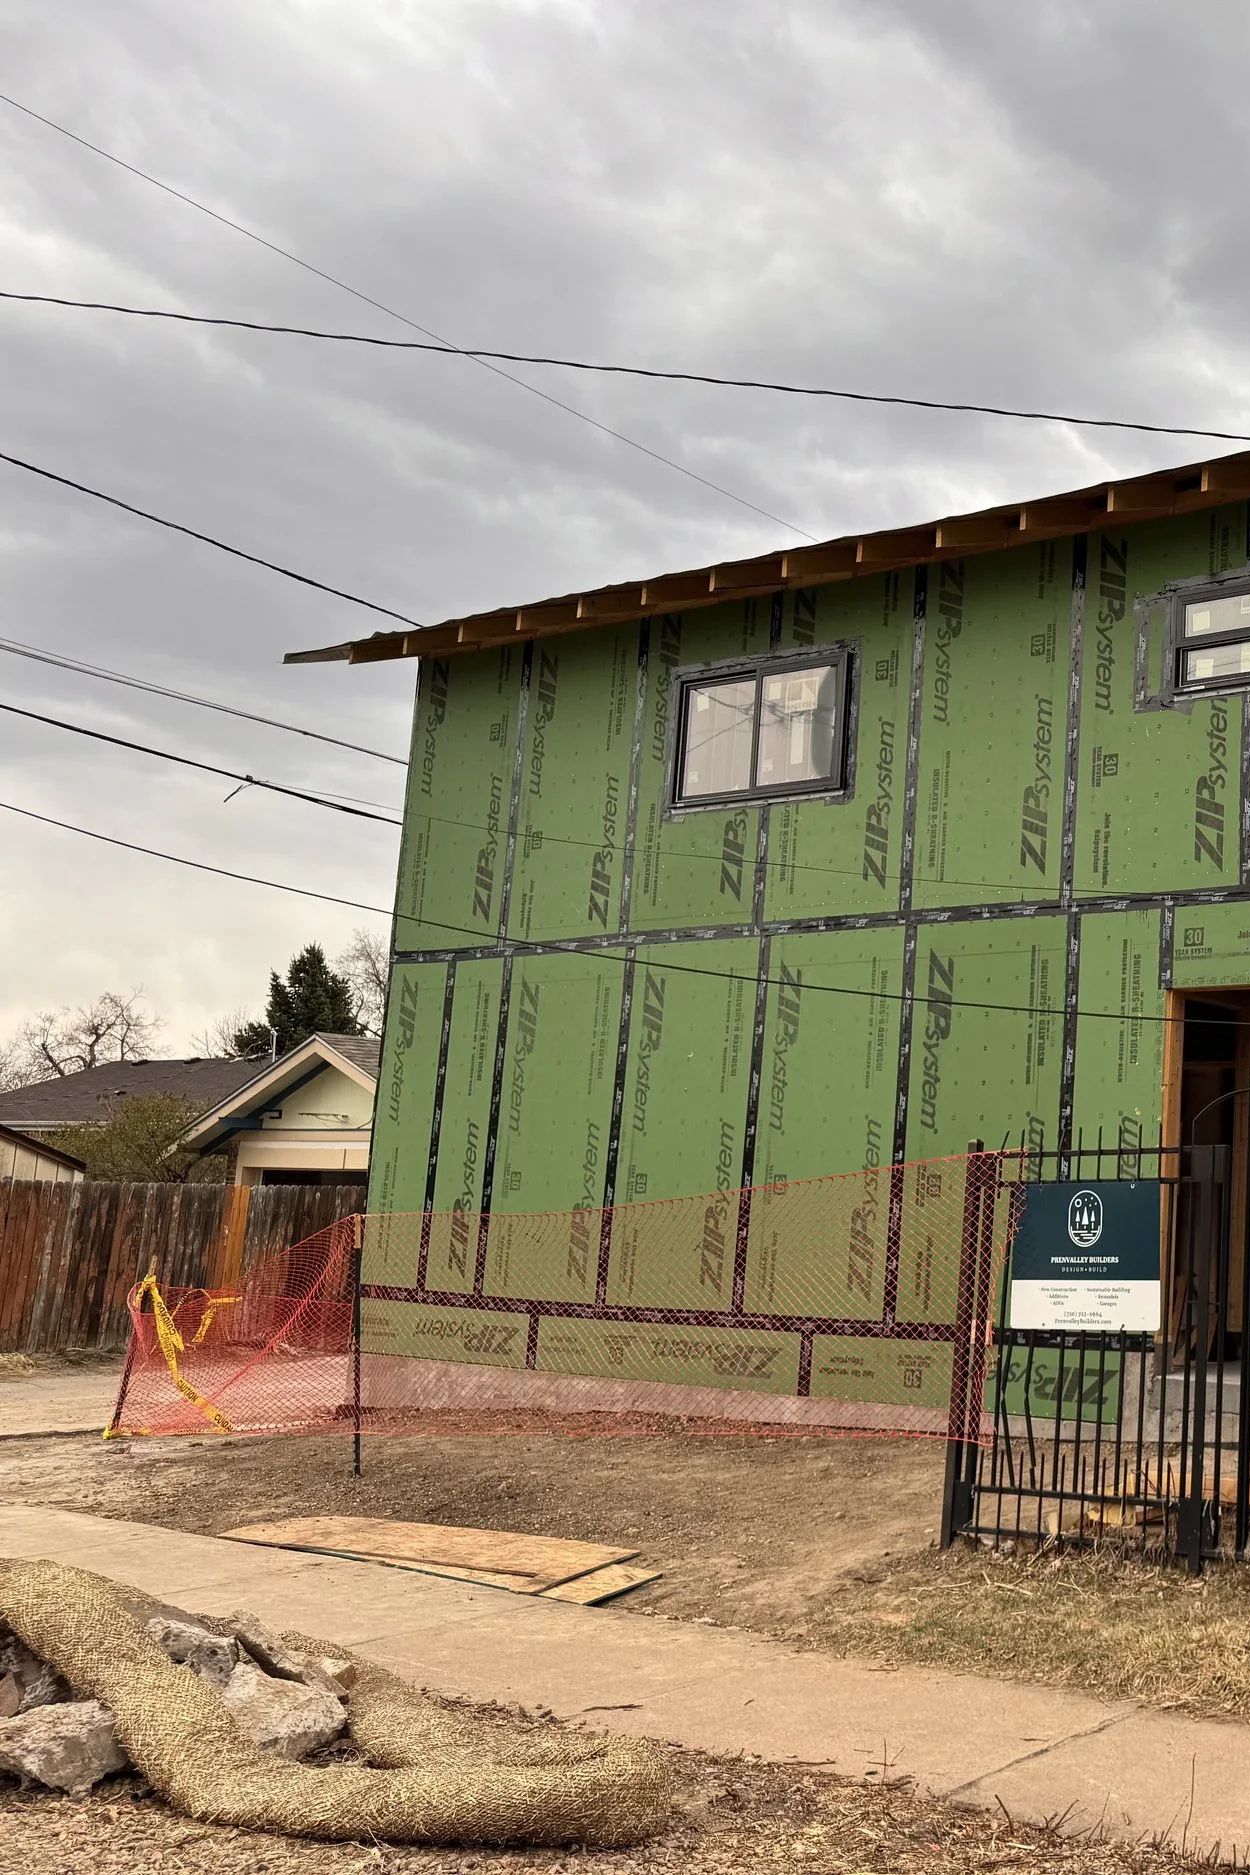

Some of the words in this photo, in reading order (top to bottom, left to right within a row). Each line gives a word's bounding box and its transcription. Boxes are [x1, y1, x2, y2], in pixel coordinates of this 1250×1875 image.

[933, 561, 965, 726] ZIPsystem
[1095, 534, 1129, 715] ZIPsystem
[472, 772, 503, 924] ZIPsystem
[588, 772, 619, 930] ZIPsystem
[863, 716, 895, 890] ZIPsystem
[1020, 694, 1053, 875] ZIPsystem
[1103, 831, 1111, 843] the
[1104, 812, 1112, 829] Join
[1131, 953, 1142, 1013] R-SHEATHING
[1175, 948, 1189, 956] YEAR
[1190, 947, 1213, 955] SYSTEM
[769, 959, 803, 1137] ZIPsystem
[921, 948, 954, 1135] ZIPsystem
[156, 1301, 176, 1336] CUIDADO
[1050, 1256, 1089, 1264] PRENVALLEY
[1089, 1256, 1119, 1264] BUILDERS
